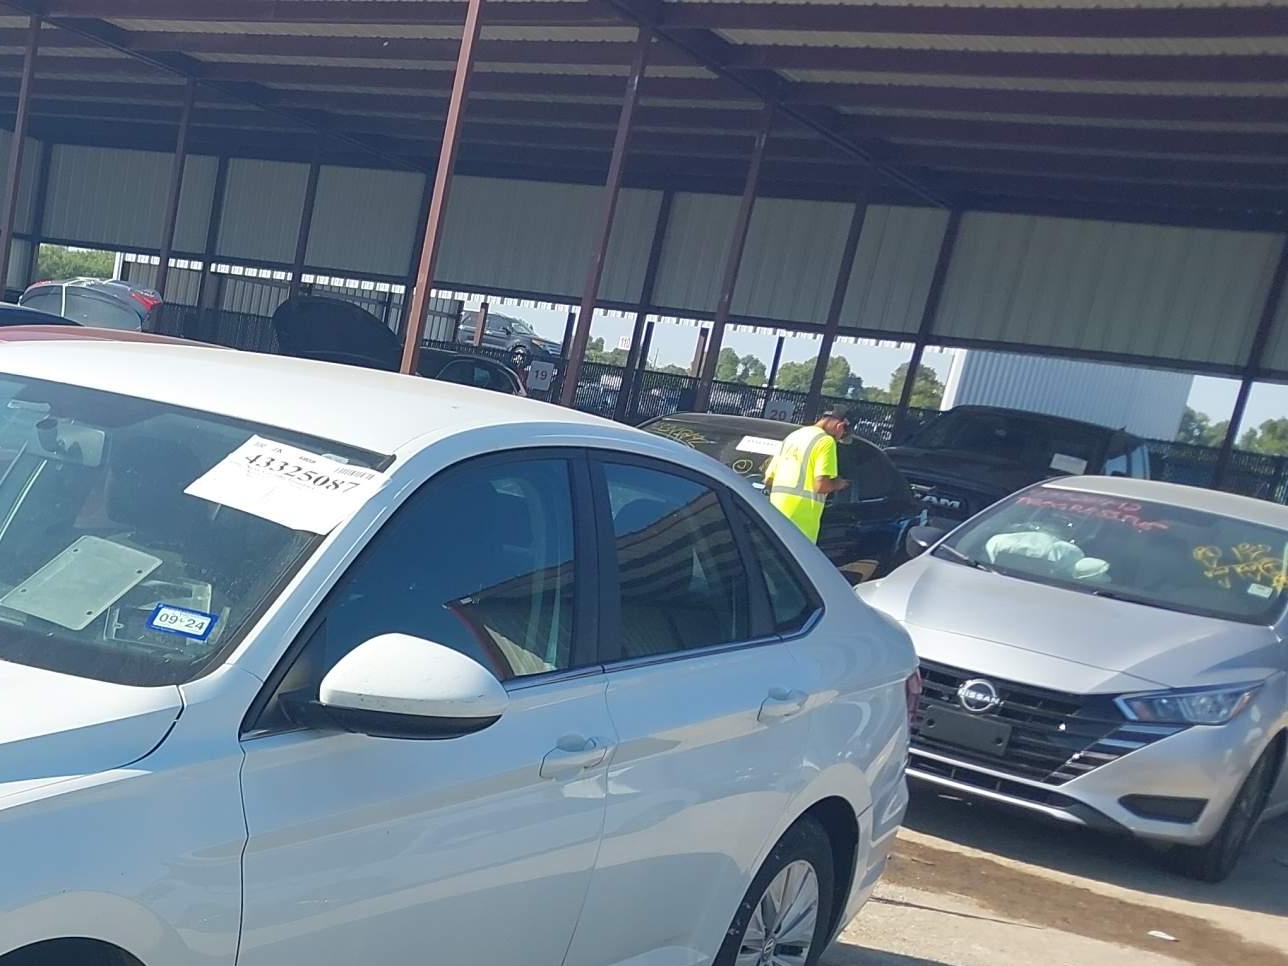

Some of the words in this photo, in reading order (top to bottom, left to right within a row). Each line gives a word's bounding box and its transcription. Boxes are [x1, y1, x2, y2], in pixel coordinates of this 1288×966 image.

[535, 370, 548, 381] 19
[770, 409, 787, 421] 20
[245, 453, 360, 493] 43325087
[159, 613, 178, 625] 09
[185, 618, 205, 631] 24
